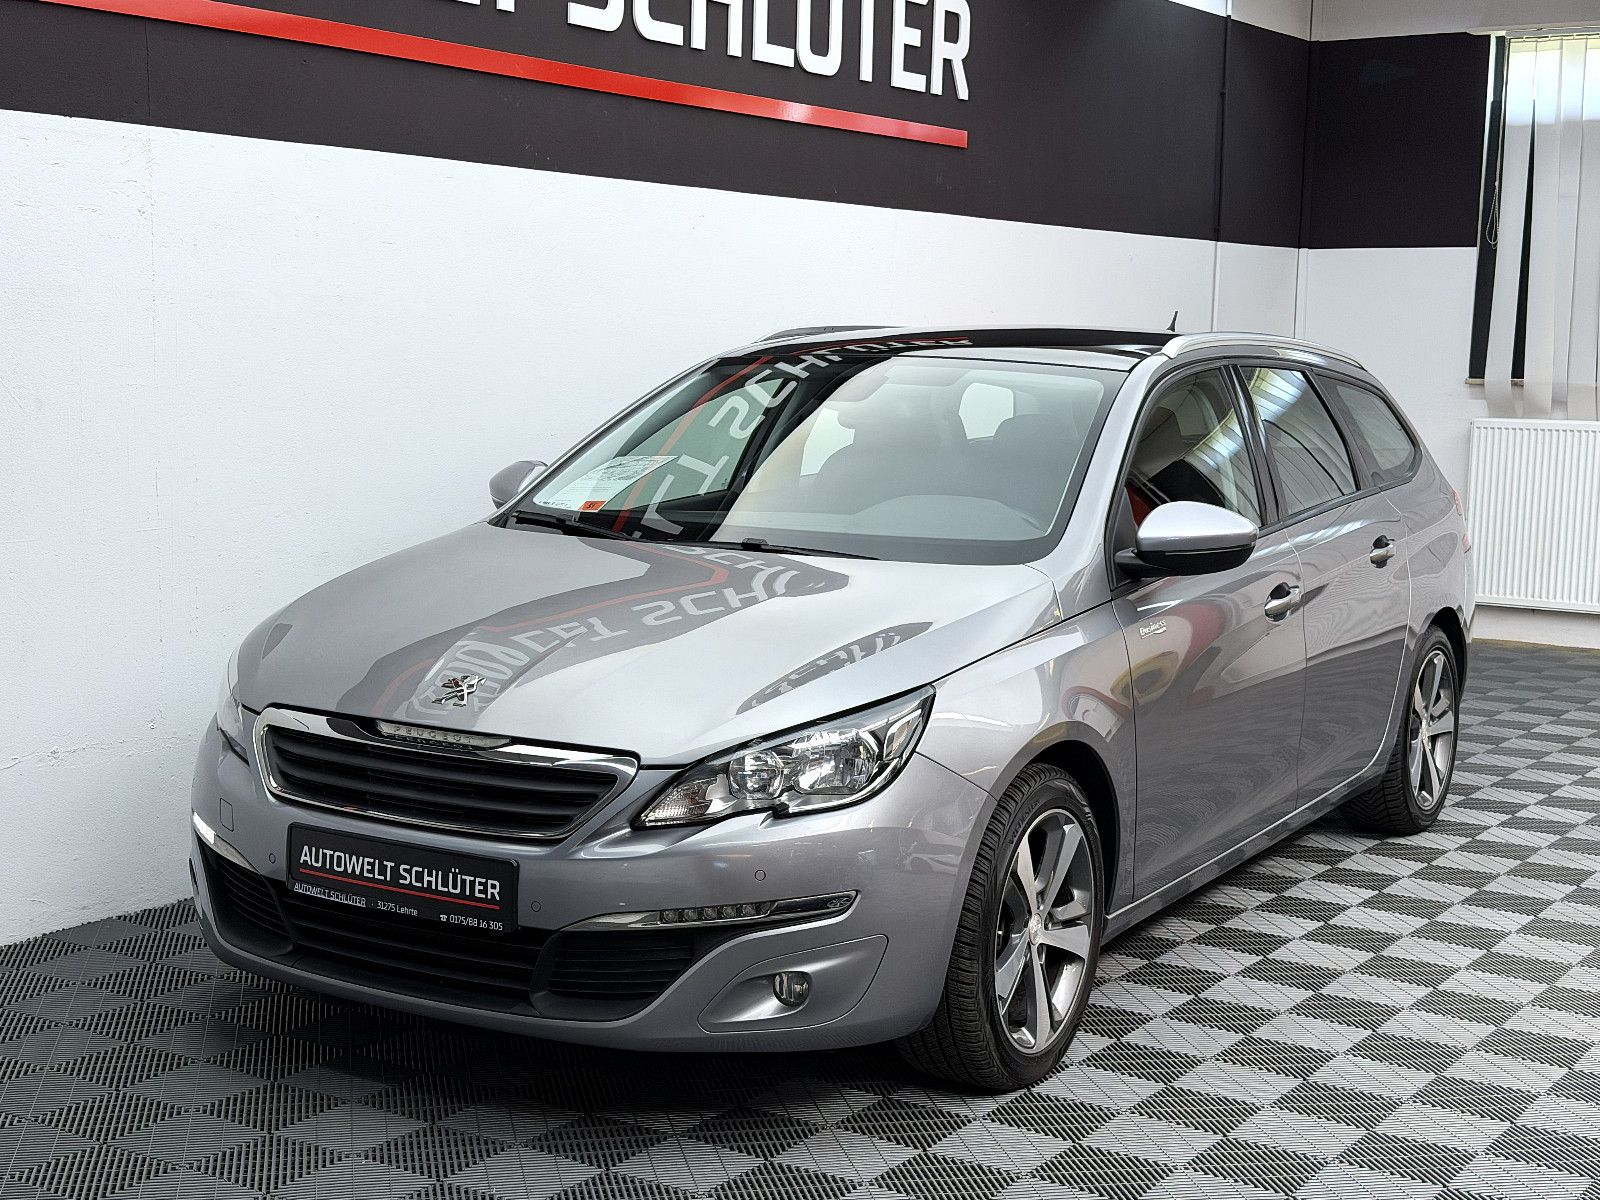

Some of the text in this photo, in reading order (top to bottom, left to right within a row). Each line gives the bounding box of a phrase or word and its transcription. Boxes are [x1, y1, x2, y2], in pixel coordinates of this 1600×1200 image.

[299, 845, 500, 901] AUTOWELT SCHLÜTER
[293, 882, 418, 917] AUTOWELT SCHLÜTER 31275 Lehrte
[449, 914, 503, 931] 0175/88 16 305
